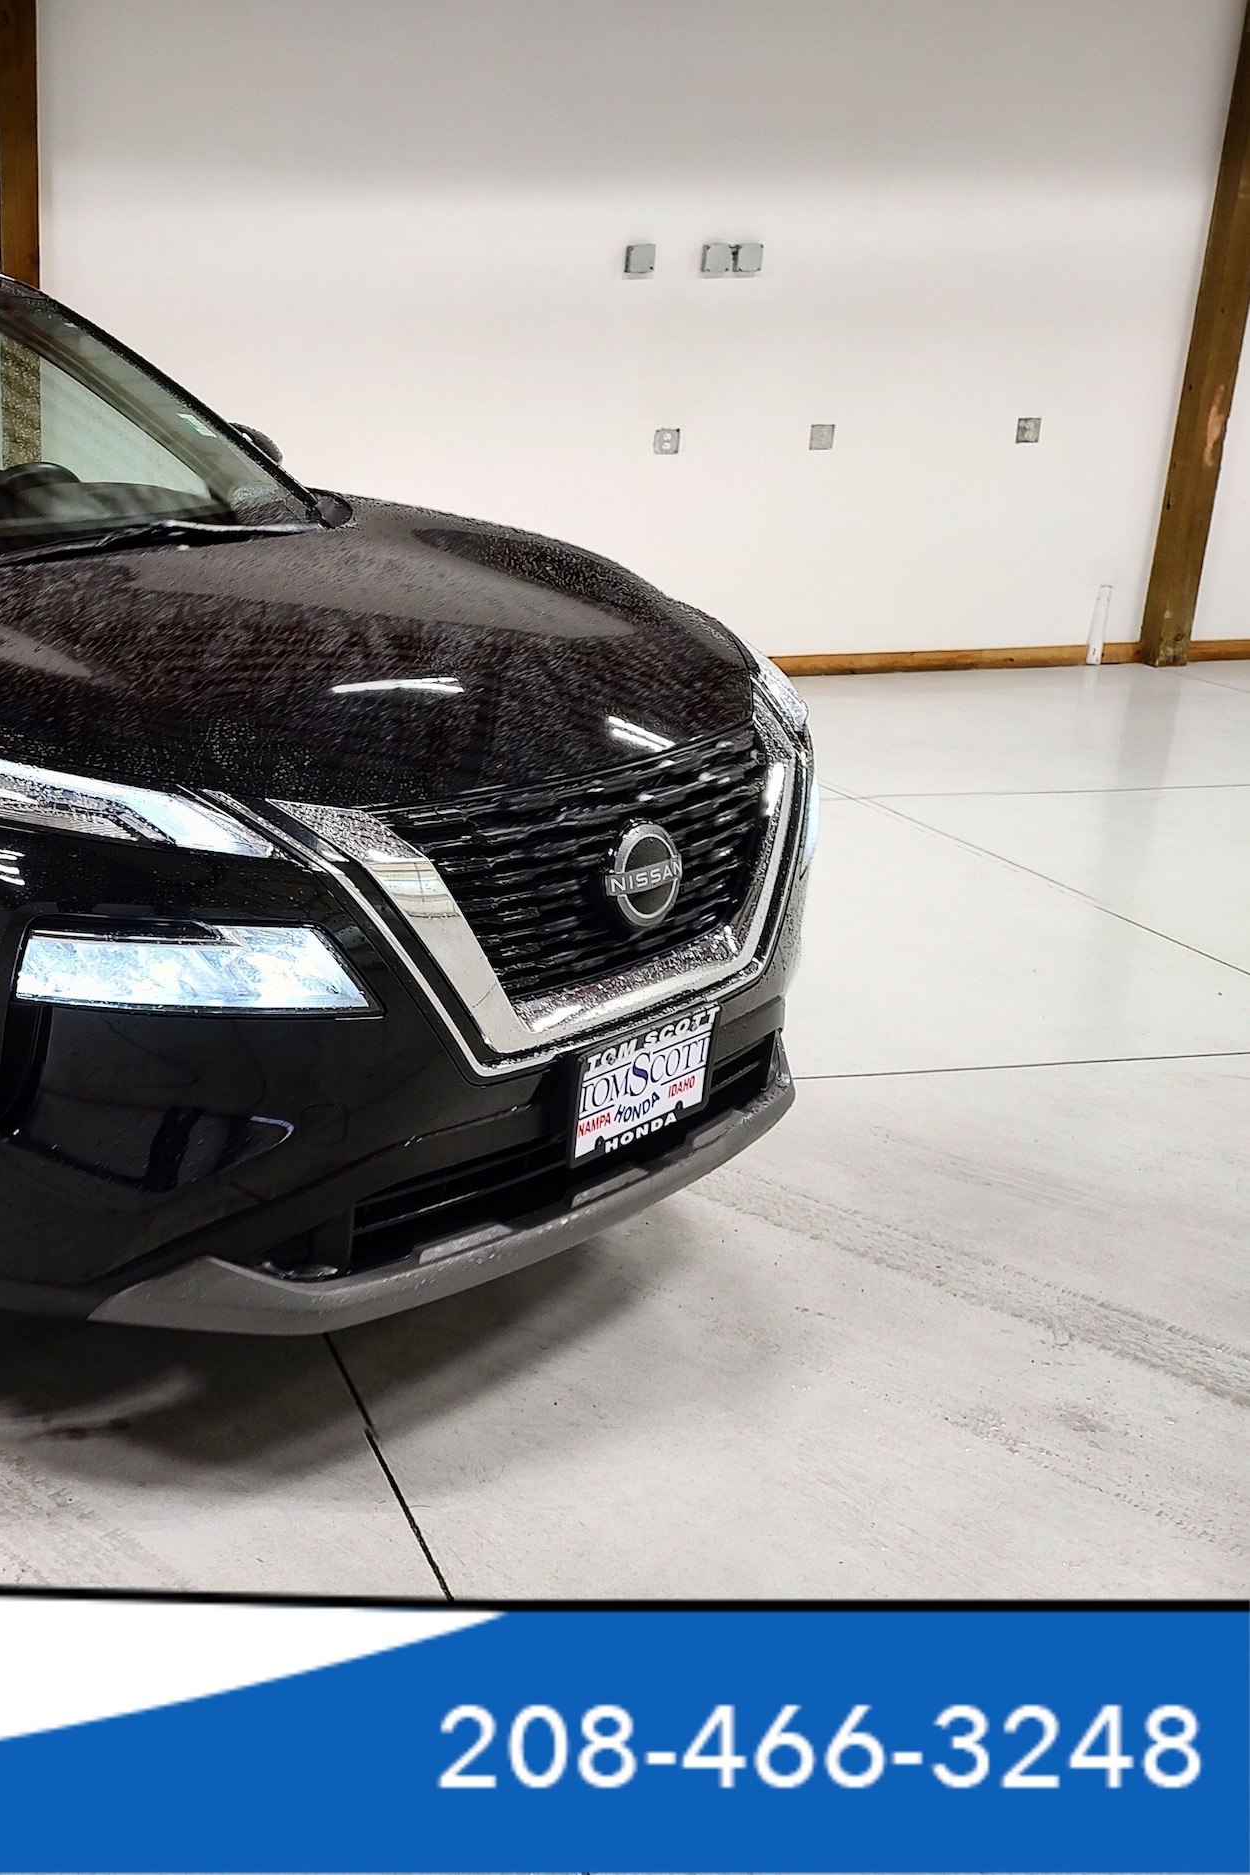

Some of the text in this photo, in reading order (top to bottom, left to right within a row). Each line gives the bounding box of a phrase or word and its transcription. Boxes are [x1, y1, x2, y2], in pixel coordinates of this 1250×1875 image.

[610, 861, 682, 893] NISSAN
[586, 1005, 721, 1072] TOM SCOTT
[577, 1075, 696, 1138] NAMPA HONDA IDAHO
[604, 1112, 678, 1154] HONDA
